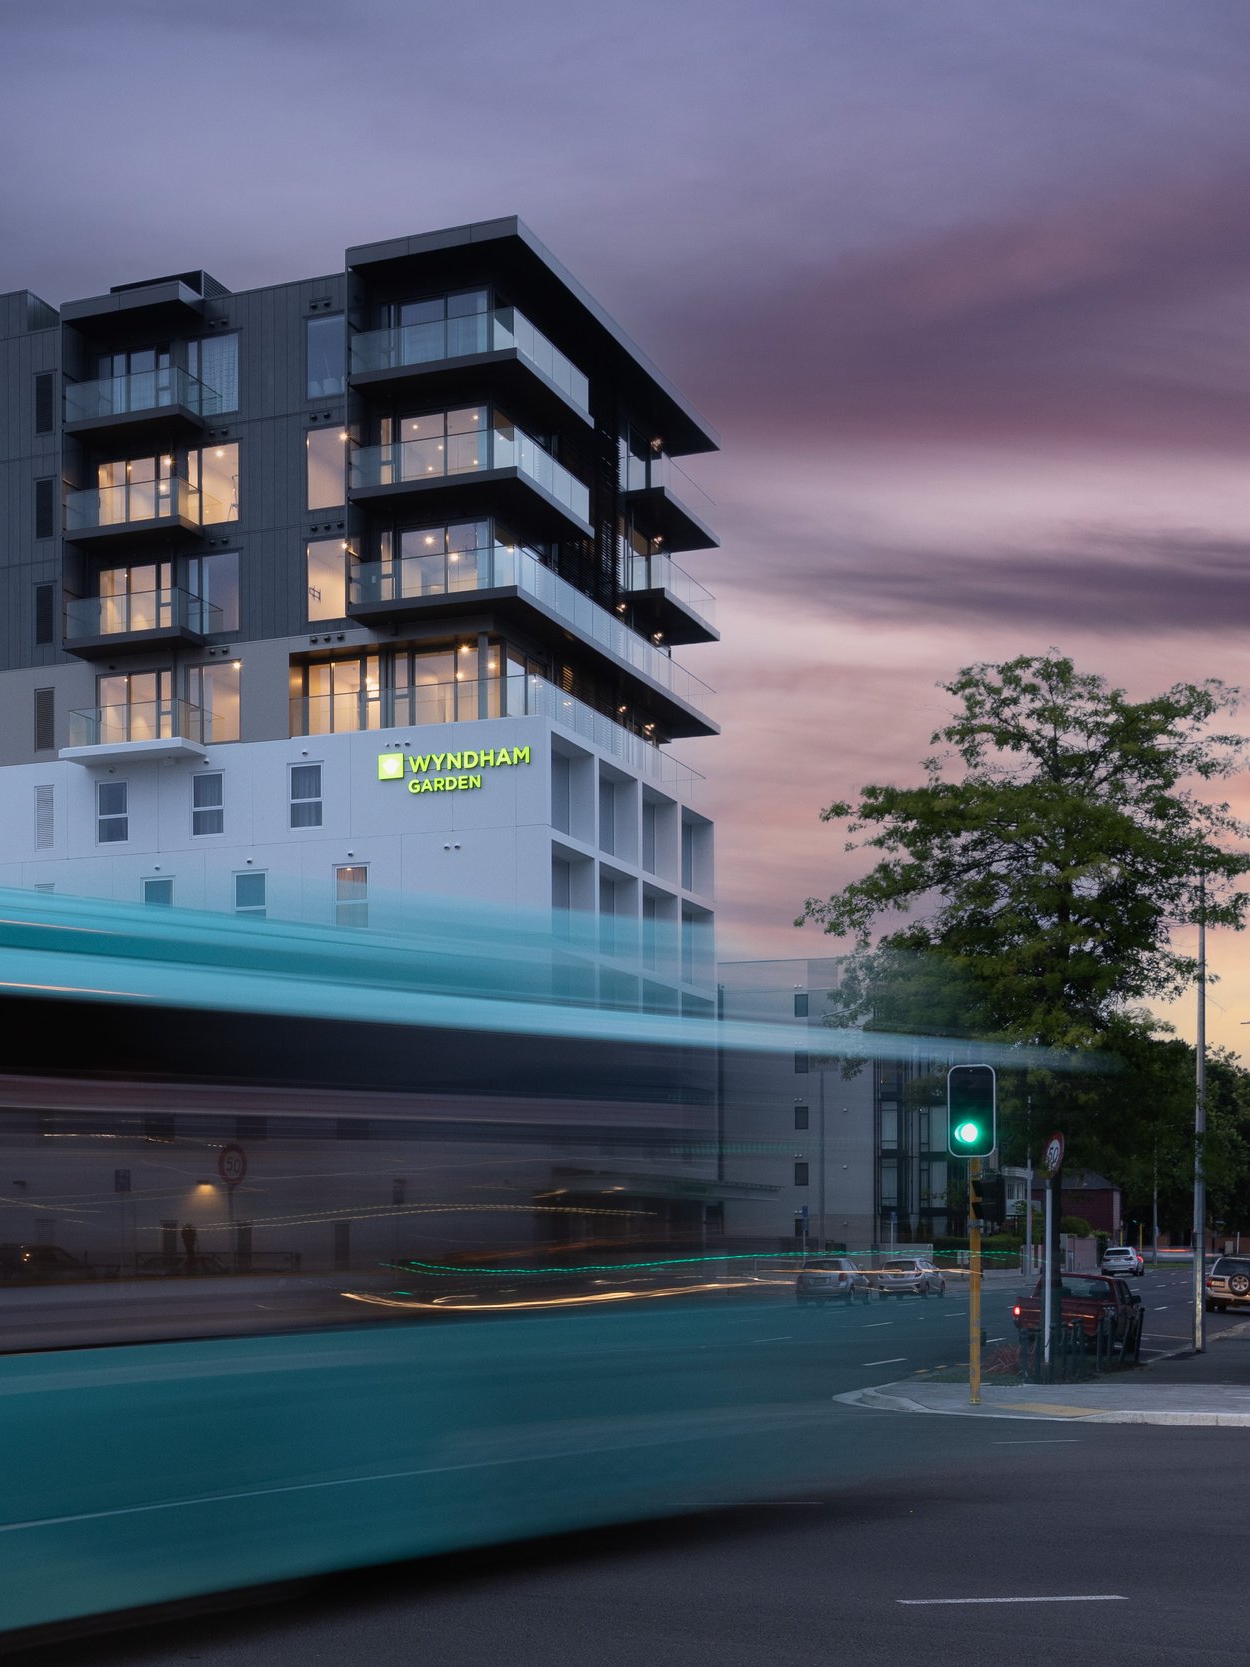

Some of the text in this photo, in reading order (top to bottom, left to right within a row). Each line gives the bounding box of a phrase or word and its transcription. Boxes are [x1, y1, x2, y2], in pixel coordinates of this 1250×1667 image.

[408, 746, 531, 773] WYNDHAM
[407, 774, 482, 794] GARDEN
[226, 1156, 241, 1173] 50
